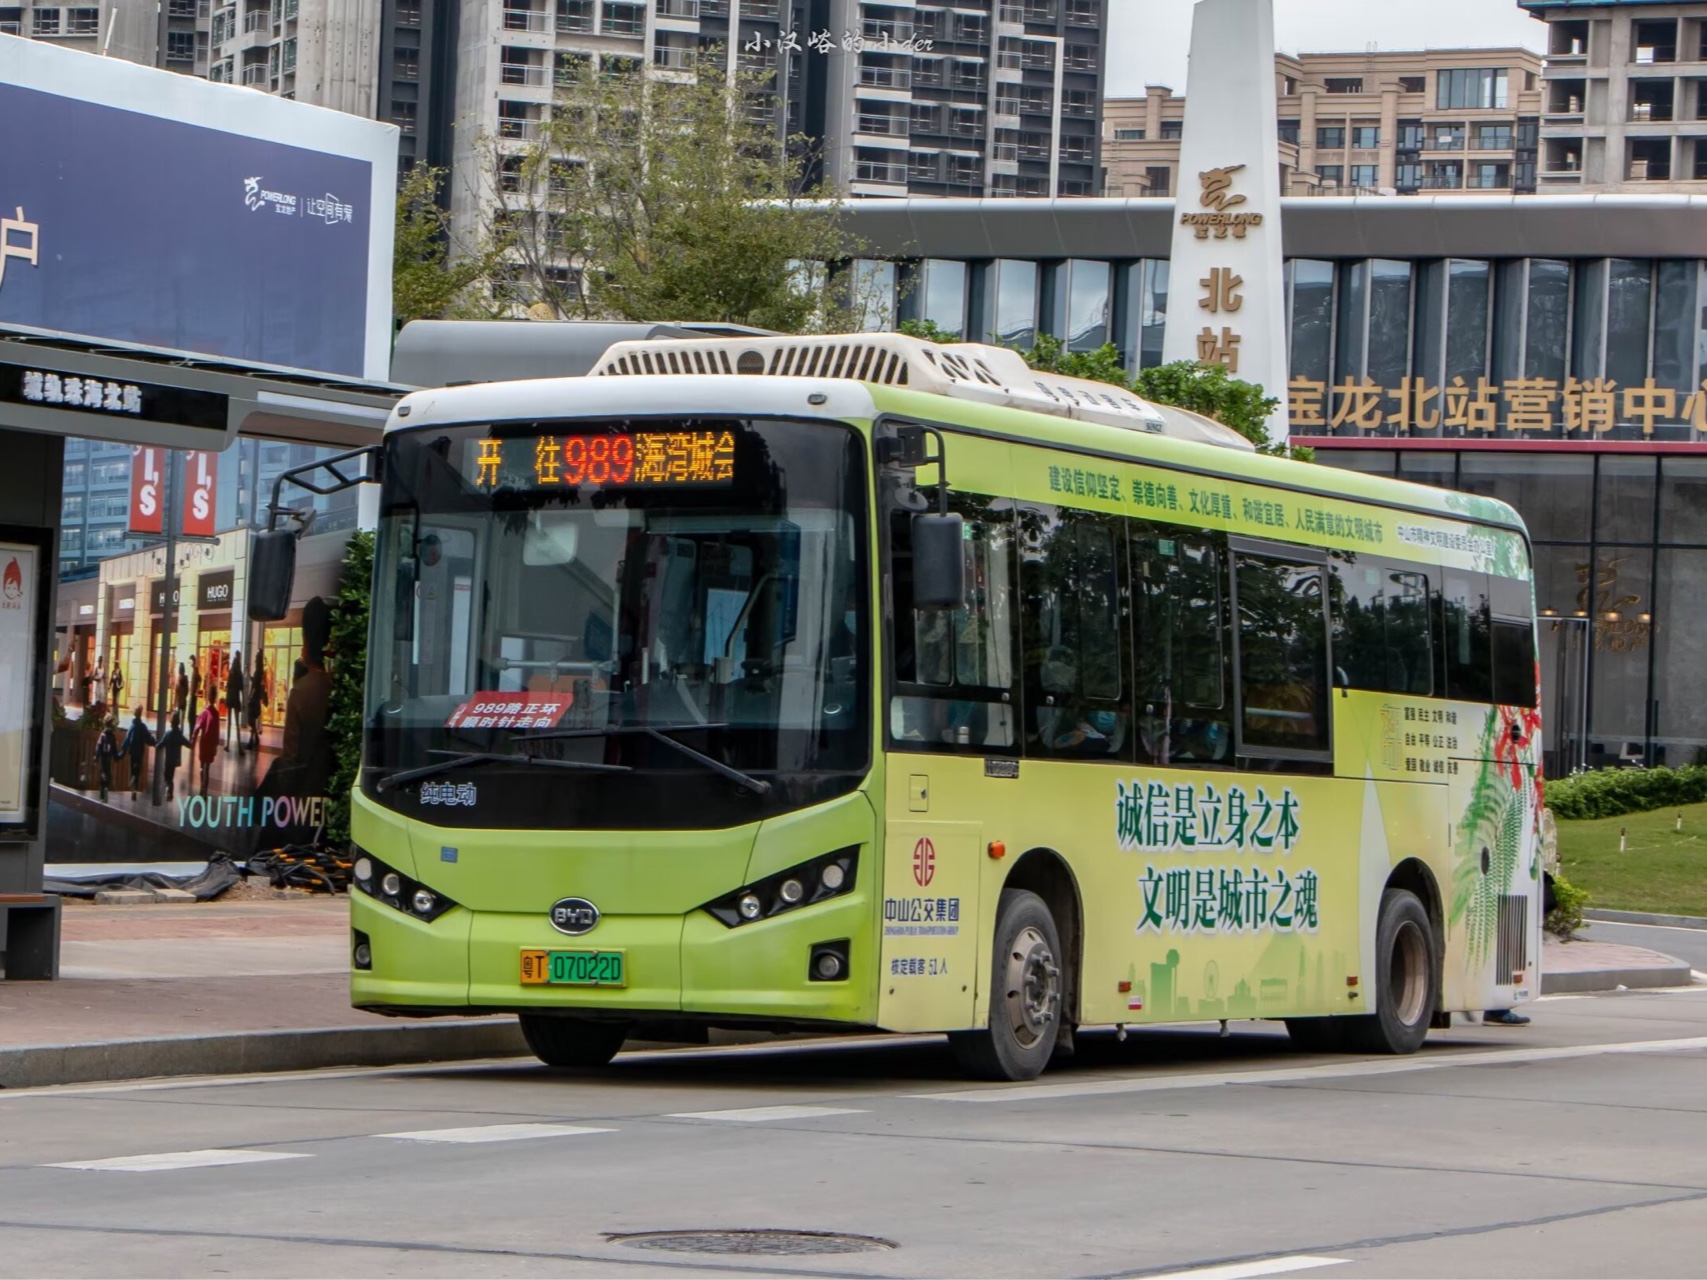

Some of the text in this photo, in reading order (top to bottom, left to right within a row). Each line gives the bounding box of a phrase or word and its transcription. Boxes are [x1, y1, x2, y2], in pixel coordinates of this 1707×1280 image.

[260, 189, 297, 206] POWERLONG
[307, 196, 353, 223] 让空间有爱
[1181, 212, 1263, 226] POWERLONG
[1196, 267, 1244, 374] 北站
[207, 584, 229, 599] HUGO
[472, 703, 561, 714] 989路正环
[459, 716, 553, 728] 顺时针走向
[420, 781, 477, 806] 纯电动
[176, 794, 254, 828] YOUTH
[1115, 782, 1300, 851] 诚信是立身之本
[884, 898, 960, 922] 中山公交集团
[1136, 866, 1319, 931] 文明是城市之魂
[554, 907, 593, 925] BYD
